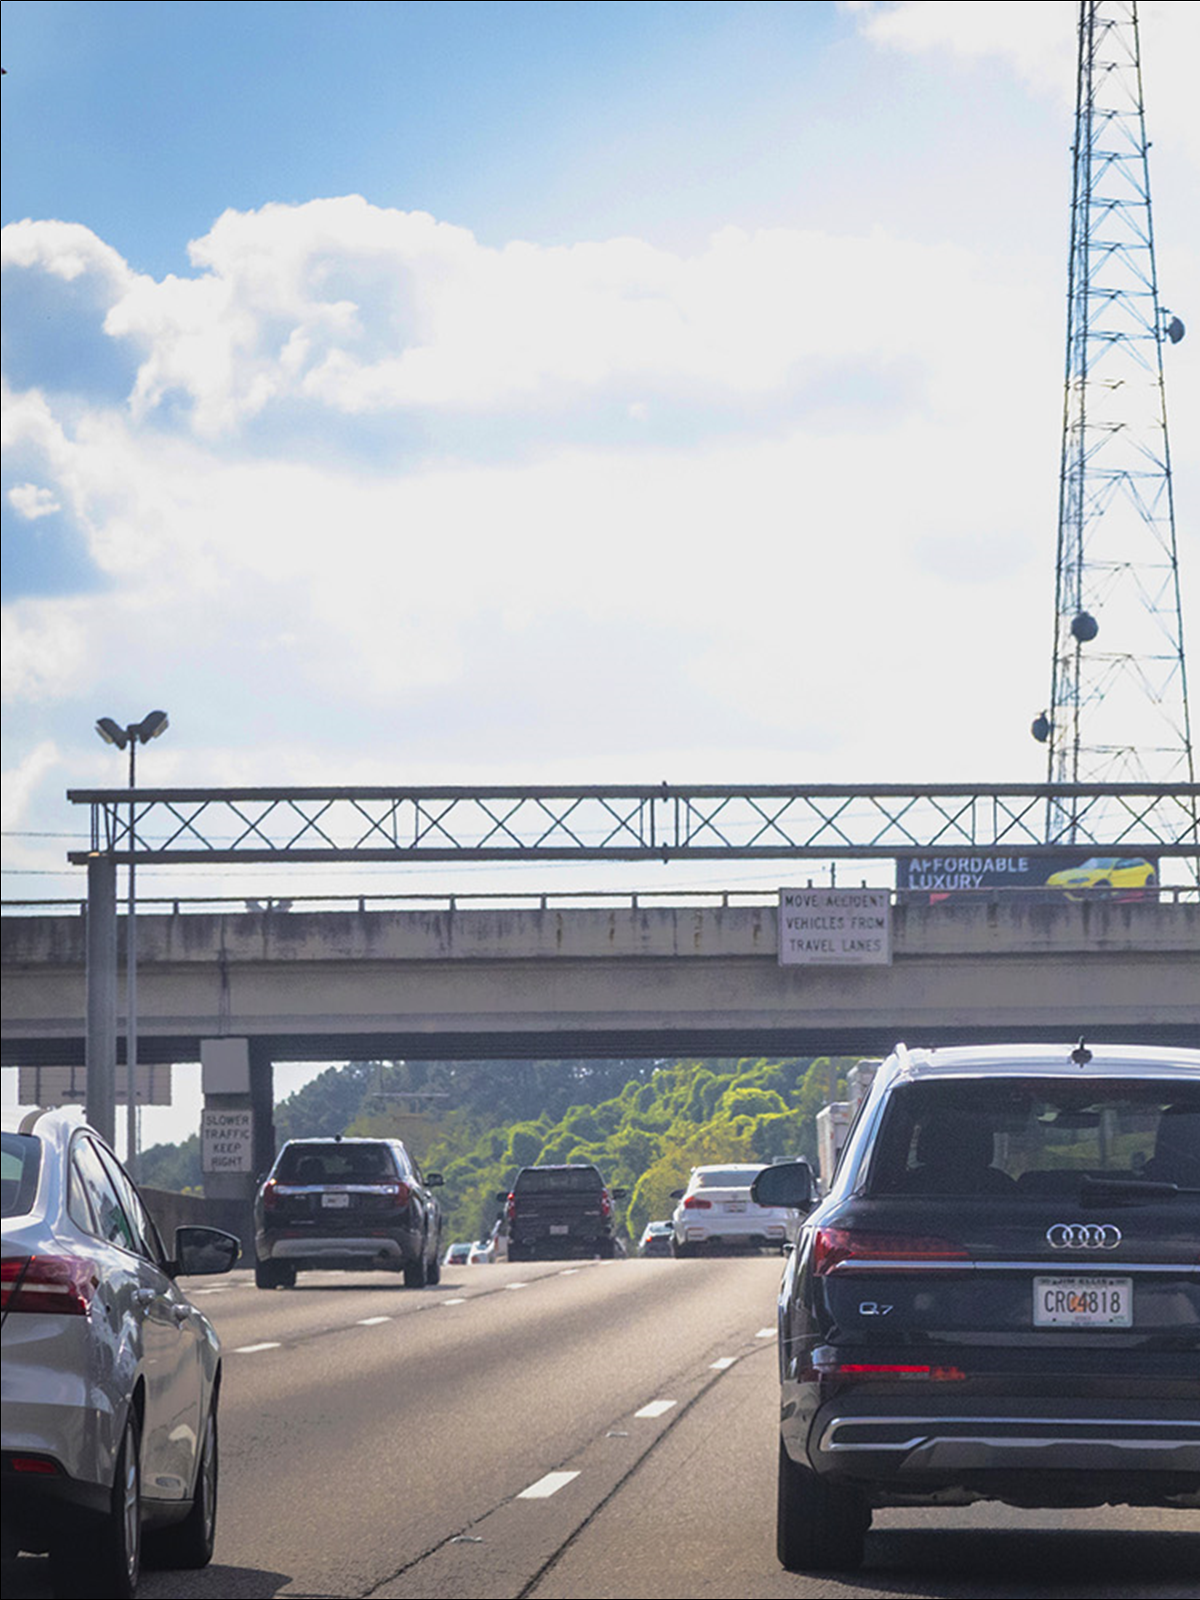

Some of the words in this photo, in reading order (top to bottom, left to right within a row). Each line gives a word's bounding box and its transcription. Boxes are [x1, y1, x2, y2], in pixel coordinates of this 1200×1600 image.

[909, 857, 1029, 873] AFFORDABLE
[909, 874, 983, 890] LUXURY
[785, 895, 819, 907] MOVE
[826, 895, 884, 907] ACCIDENT
[786, 917, 844, 930] VEHICLES
[851, 917, 884, 930] FROM
[790, 939, 835, 952] TRAVEL
[842, 939, 881, 952] LANES
[206, 1115, 249, 1126] SLOWER
[205, 1129, 250, 1140] TRAFFIC
[213, 1143, 242, 1153] KEEP
[859, 1301, 893, 1315] Q7
[1044, 1290, 1121, 1313] CRC4818
